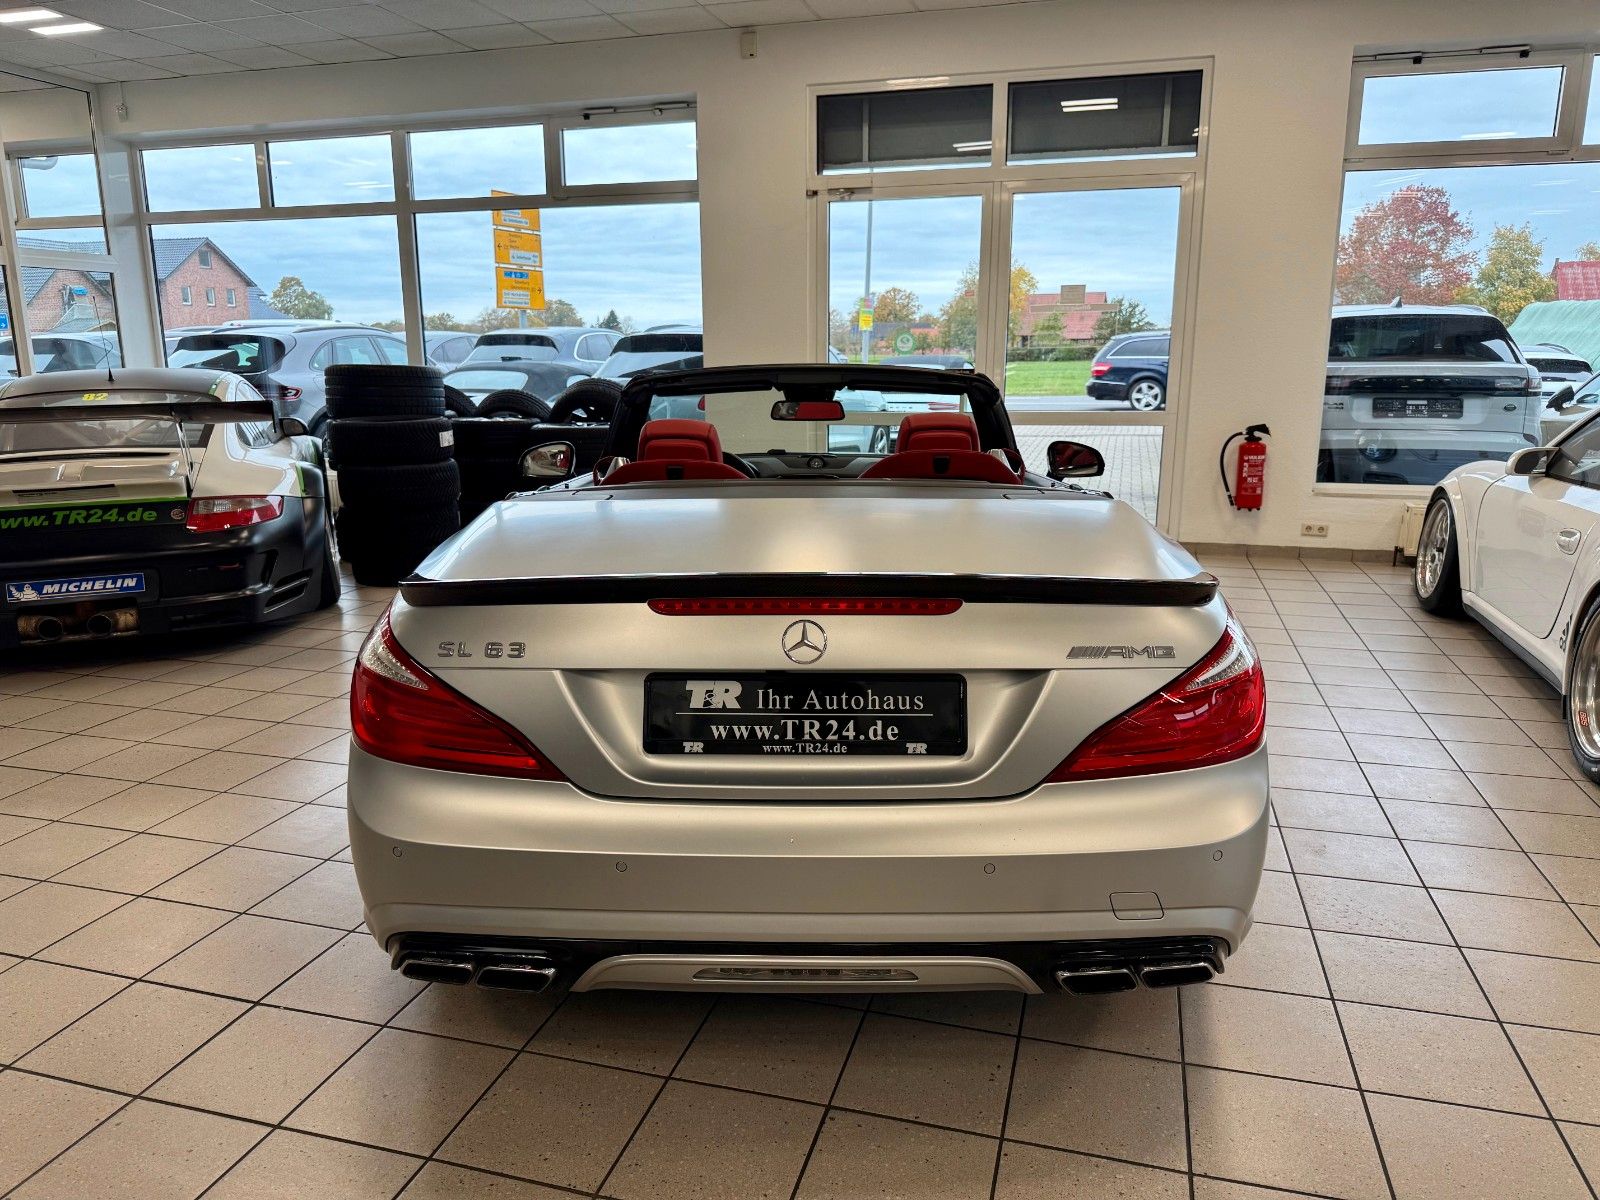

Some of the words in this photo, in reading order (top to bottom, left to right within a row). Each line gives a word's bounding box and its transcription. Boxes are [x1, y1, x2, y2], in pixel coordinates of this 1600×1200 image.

[42, 577, 138, 594] MICHELIN
[437, 641, 473, 658] SL
[484, 641, 526, 659] 63
[1101, 645, 1176, 659] AMG
[757, 688, 794, 710] Ihr
[801, 689, 925, 711] Autohaus
[710, 719, 900, 741] www.TR24.de
[762, 742, 848, 754] www.TR24.de
